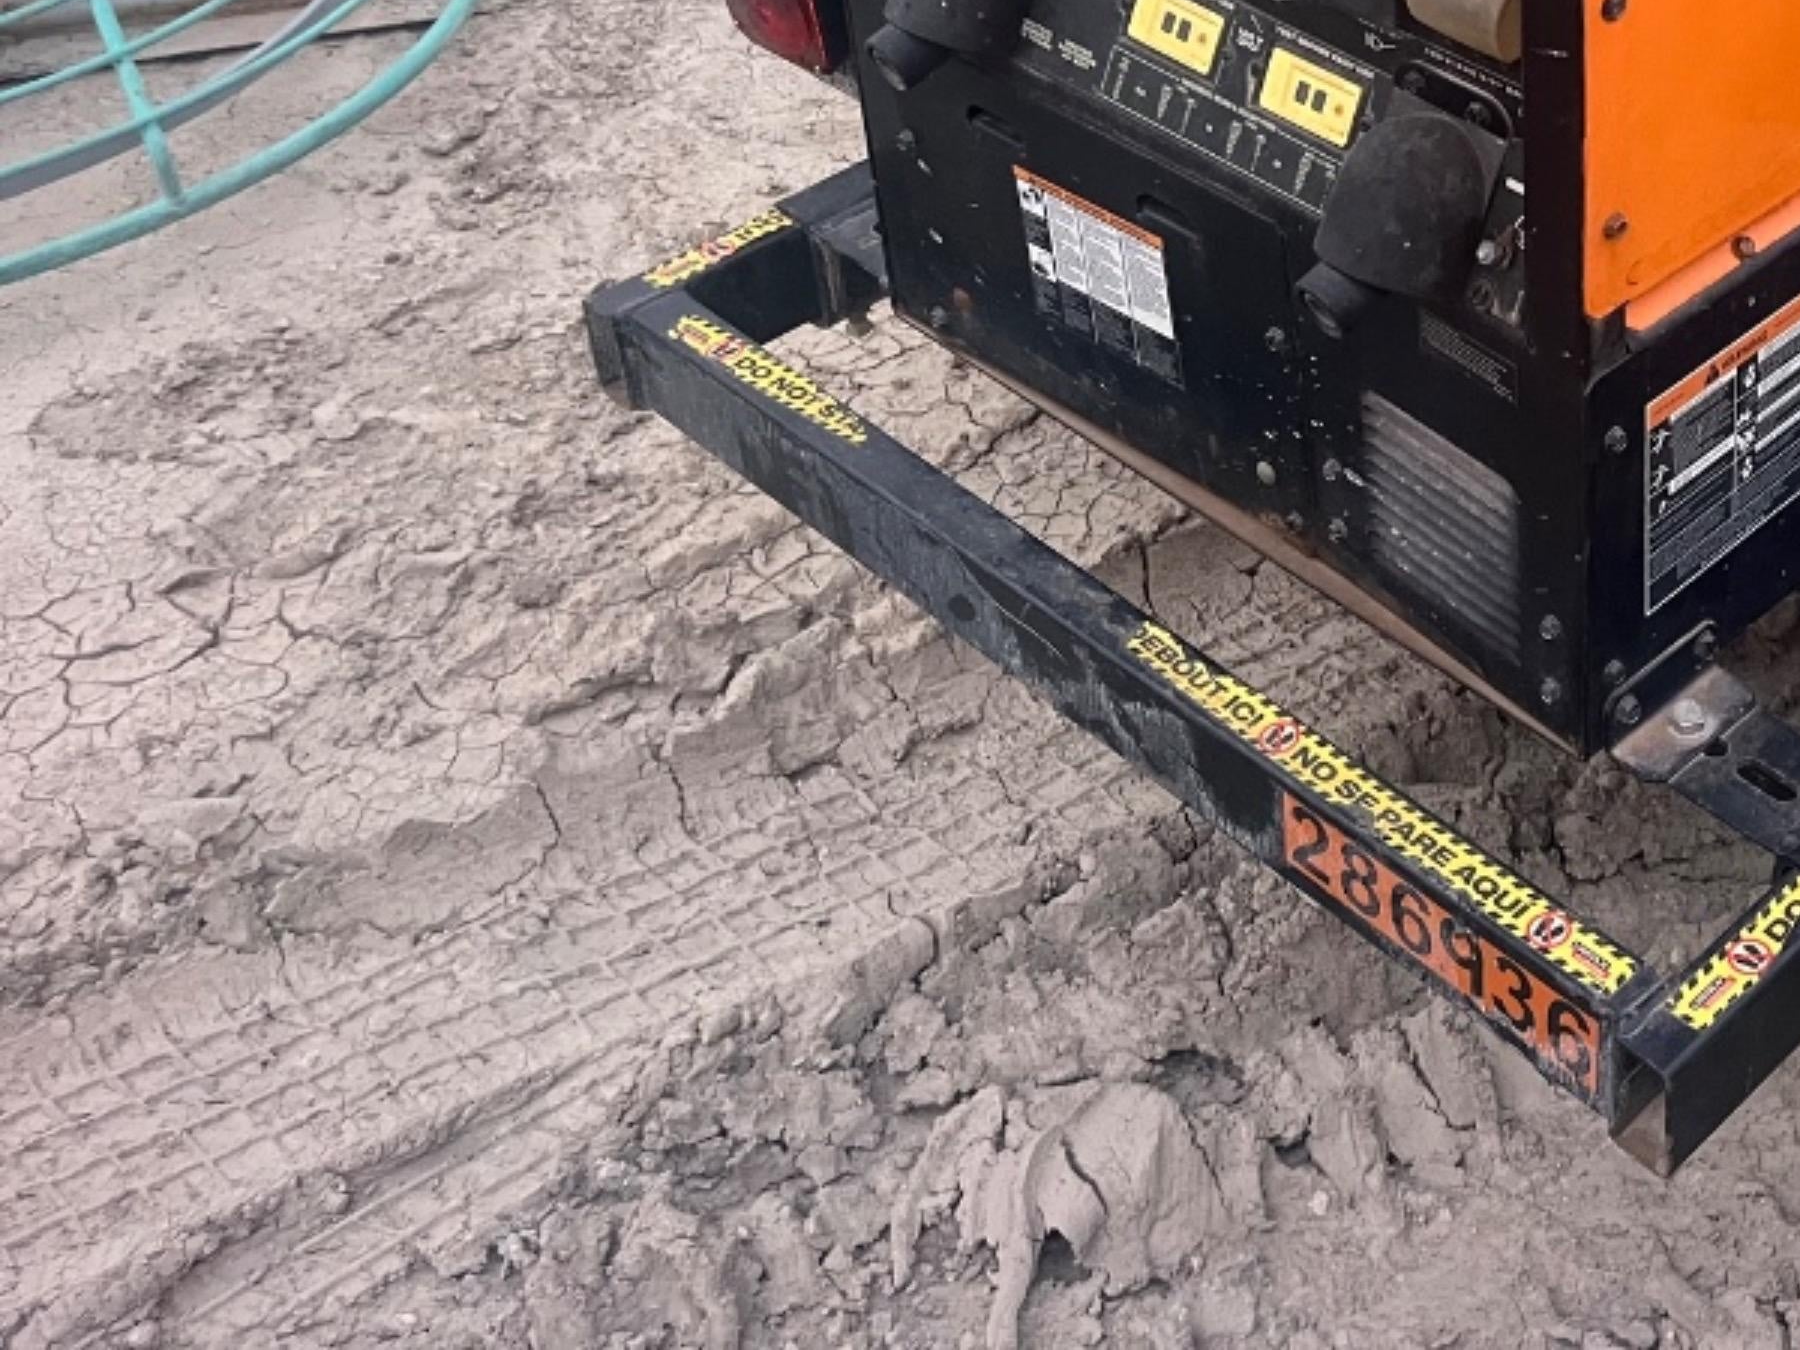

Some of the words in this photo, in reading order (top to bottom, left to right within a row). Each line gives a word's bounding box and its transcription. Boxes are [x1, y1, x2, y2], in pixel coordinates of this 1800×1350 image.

[1223, 693, 1265, 729] ICI
[1290, 745, 1337, 782] NO
[1377, 806, 1457, 870] PARE
[1289, 804, 1595, 1082] 286936
